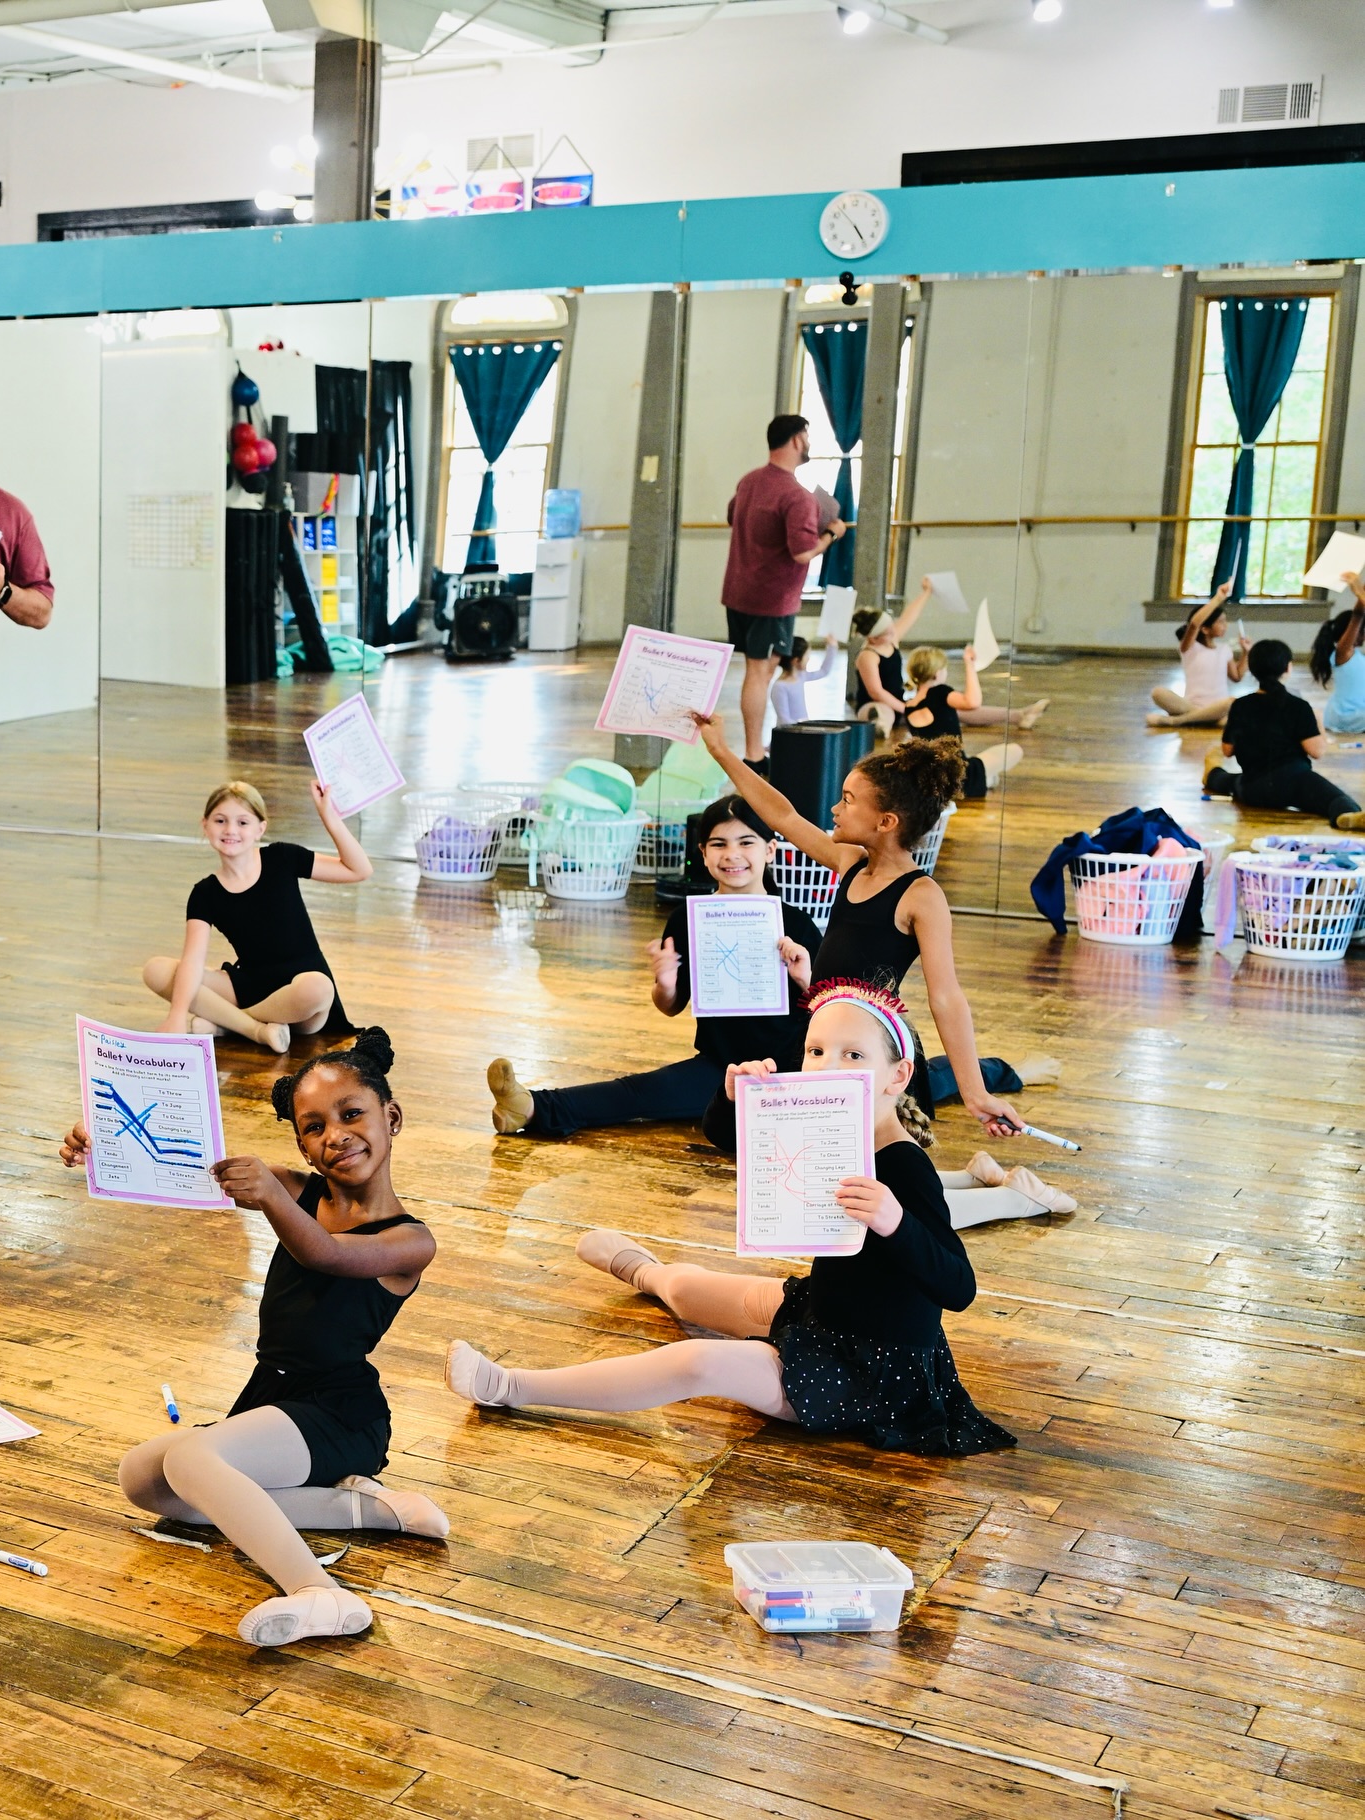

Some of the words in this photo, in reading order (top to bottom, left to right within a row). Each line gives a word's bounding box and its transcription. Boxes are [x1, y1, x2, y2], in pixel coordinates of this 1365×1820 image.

[727, 910, 766, 918] Vocabulary
[97, 1047, 122, 1061] Ballet
[125, 1054, 186, 1071] Vocabulary
[760, 1098, 788, 1108] Ballet
[791, 1096, 846, 1106] Vocabulary
[101, 1161, 129, 1169] Changement
